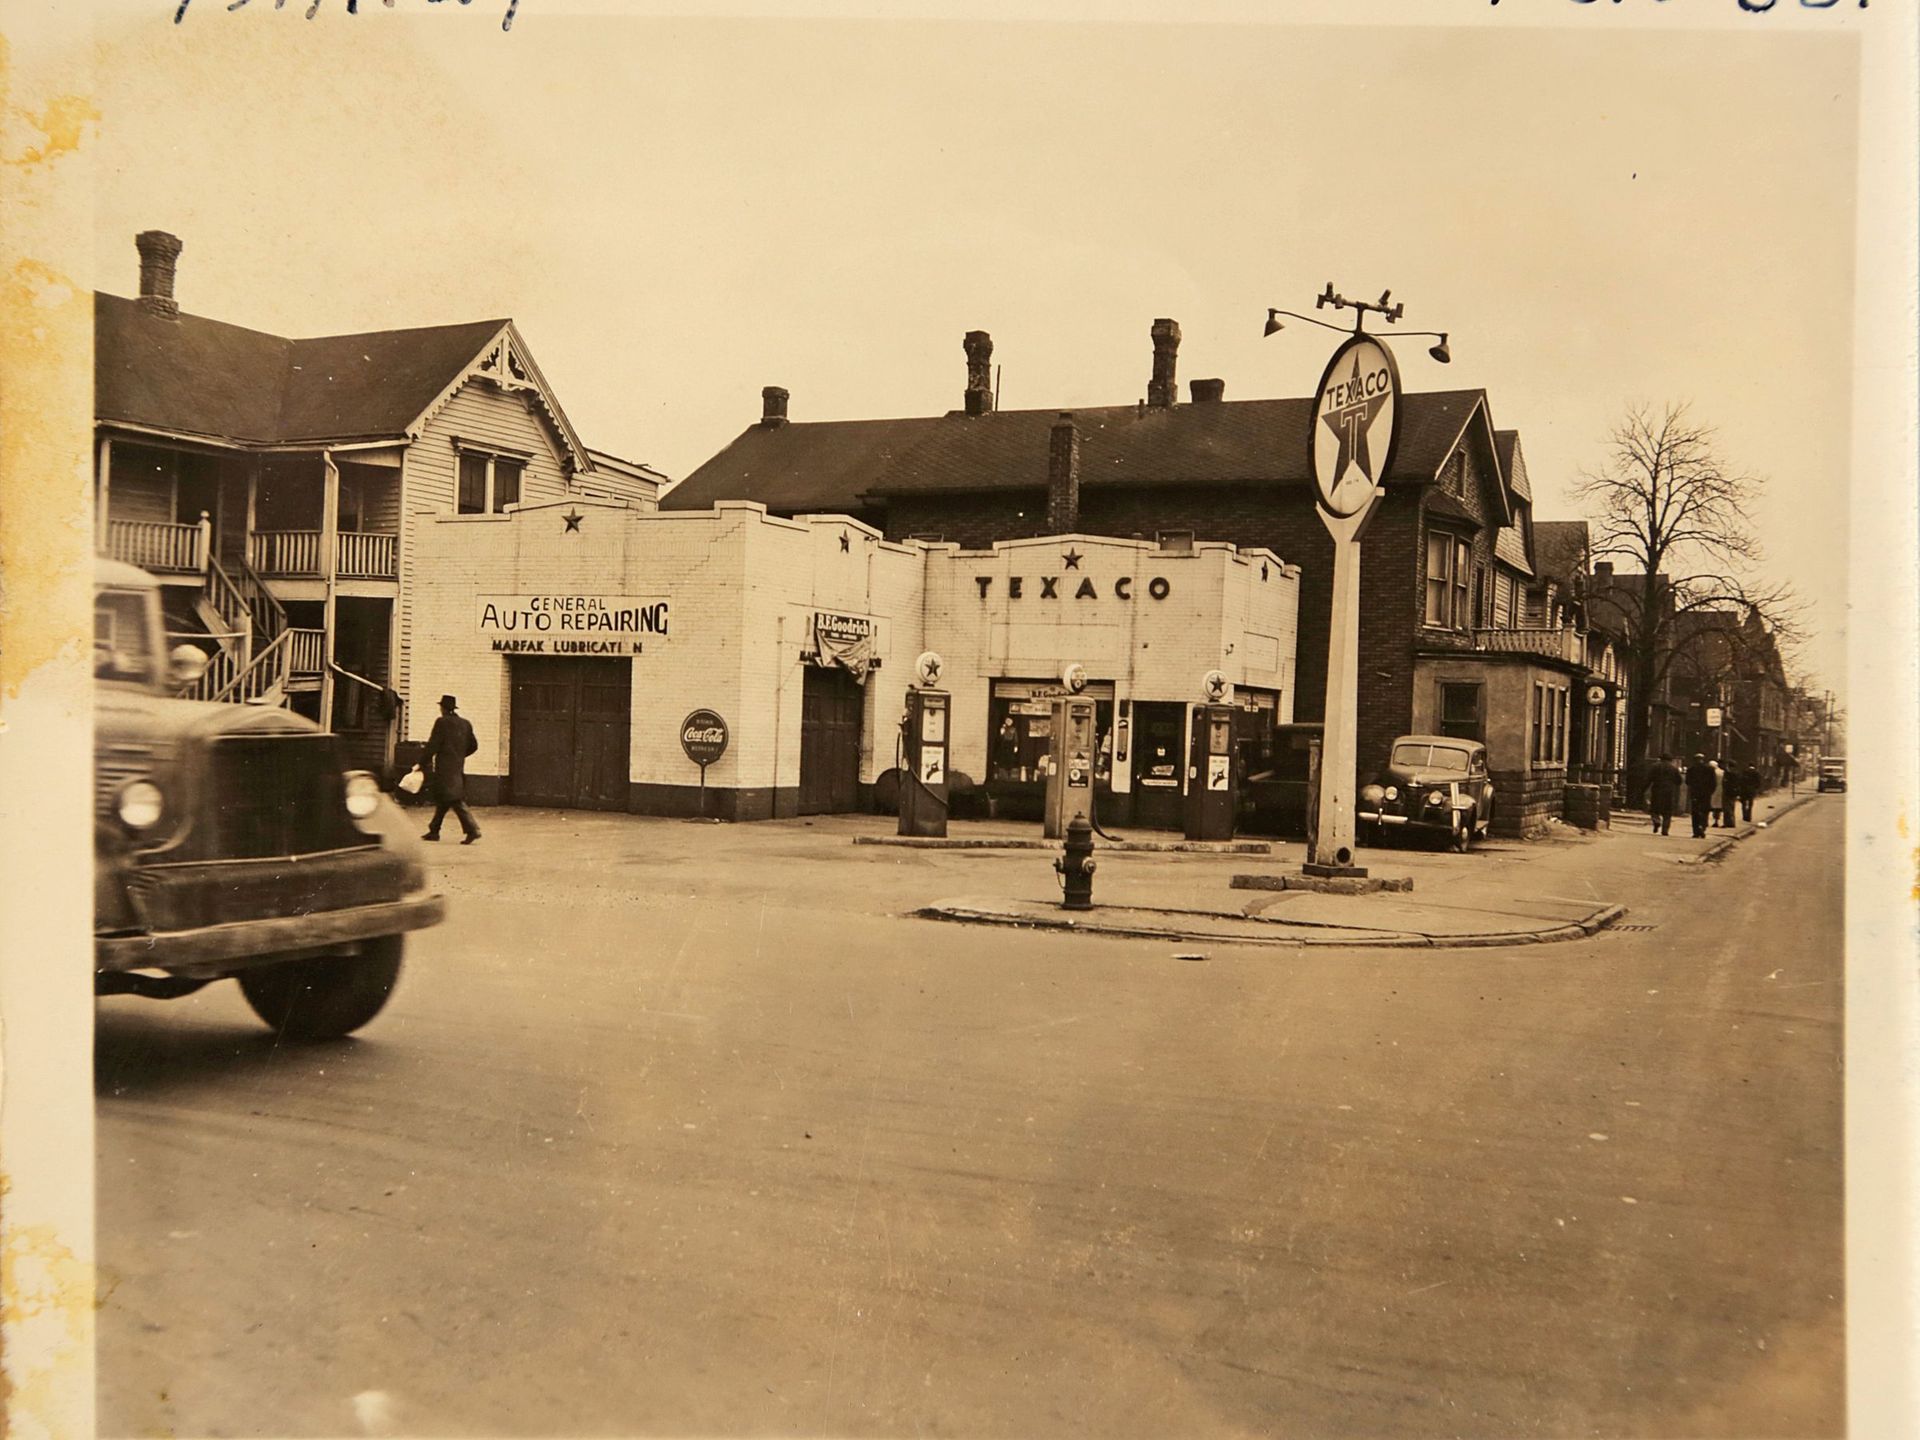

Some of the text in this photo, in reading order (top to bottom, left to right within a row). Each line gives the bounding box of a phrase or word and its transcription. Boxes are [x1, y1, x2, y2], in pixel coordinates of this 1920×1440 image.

[1326, 368, 1389, 411] TEXACO
[1340, 402, 1368, 461] T
[975, 576, 1170, 600] TEXACO
[530, 597, 606, 611] GENERAL
[481, 602, 668, 635] AUTO REPAIRING
[492, 640, 545, 652] MARFAK
[684, 726, 724, 743] Coca-Cola
